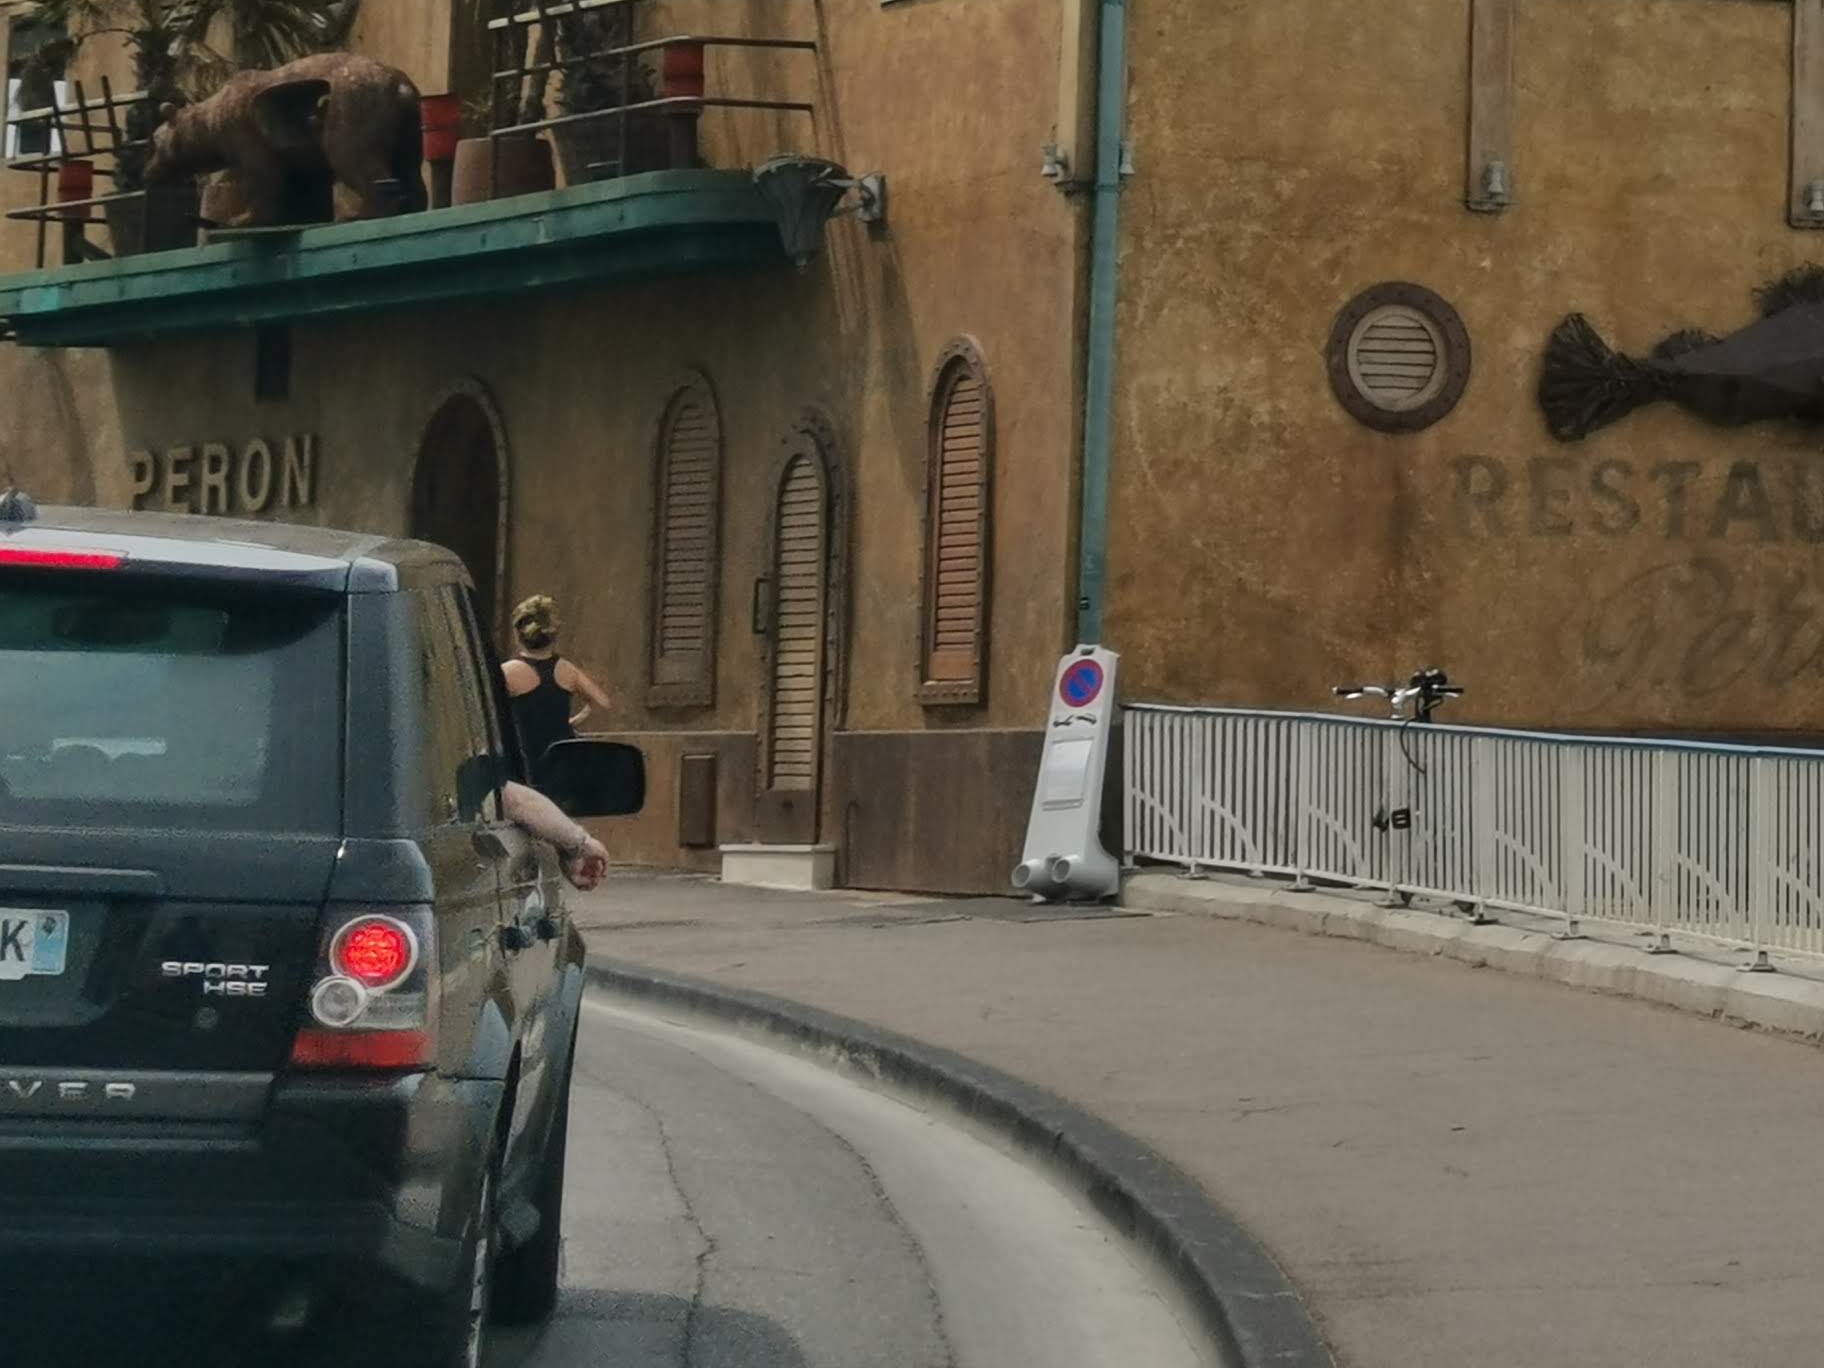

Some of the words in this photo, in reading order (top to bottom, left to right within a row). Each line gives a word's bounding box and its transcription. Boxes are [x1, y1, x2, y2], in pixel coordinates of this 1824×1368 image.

[129, 433, 313, 514] PERON
[161, 961, 270, 979] SPORT
[203, 980, 268, 996] HSE
